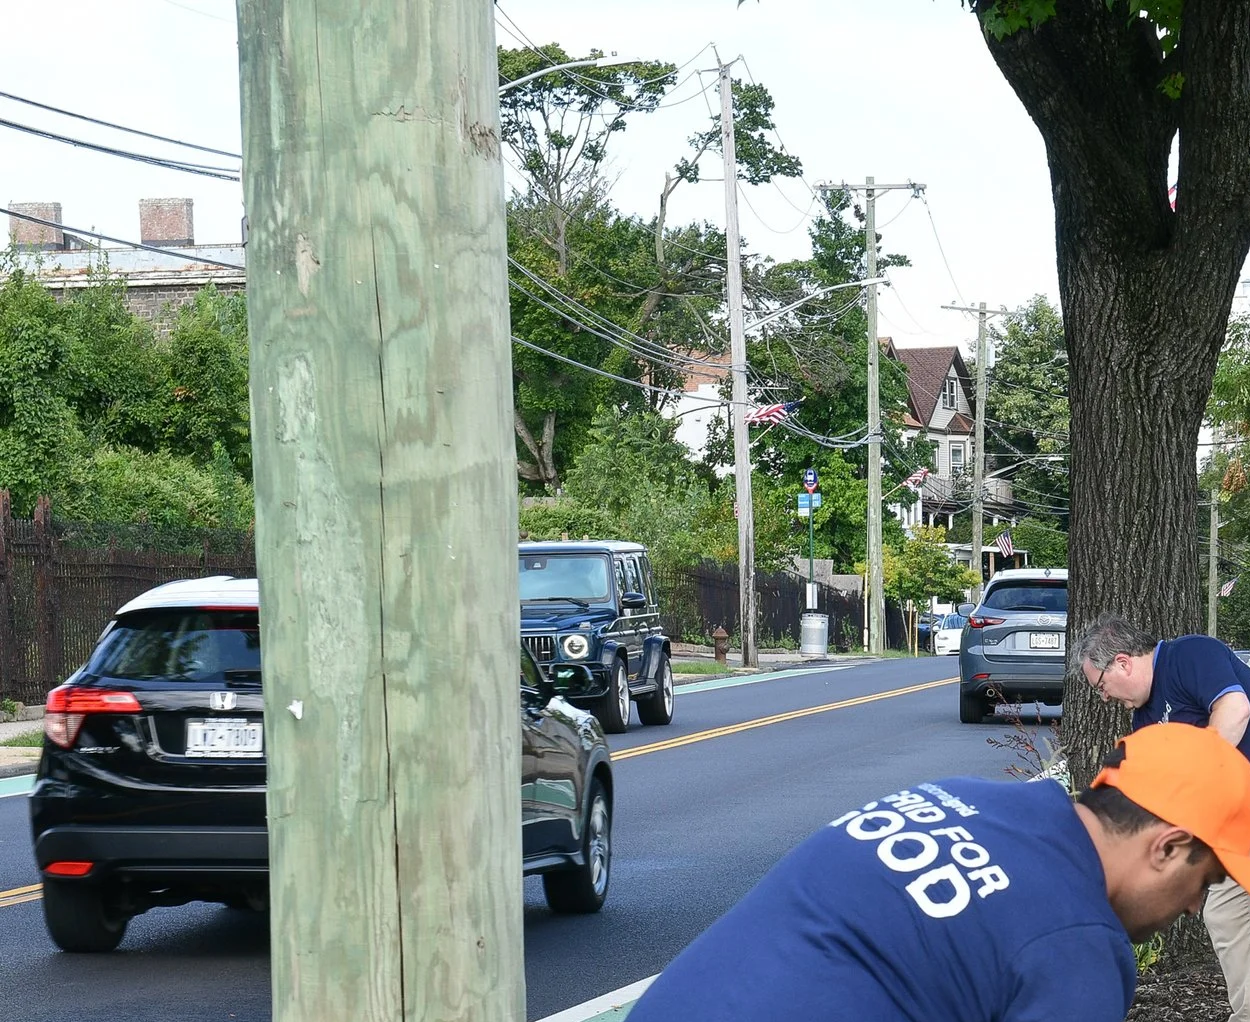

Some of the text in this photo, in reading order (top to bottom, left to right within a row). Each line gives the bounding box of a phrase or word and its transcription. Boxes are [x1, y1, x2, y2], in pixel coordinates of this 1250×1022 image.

[829, 801, 971, 918] OOD
[881, 790, 1010, 899] RID FOR
